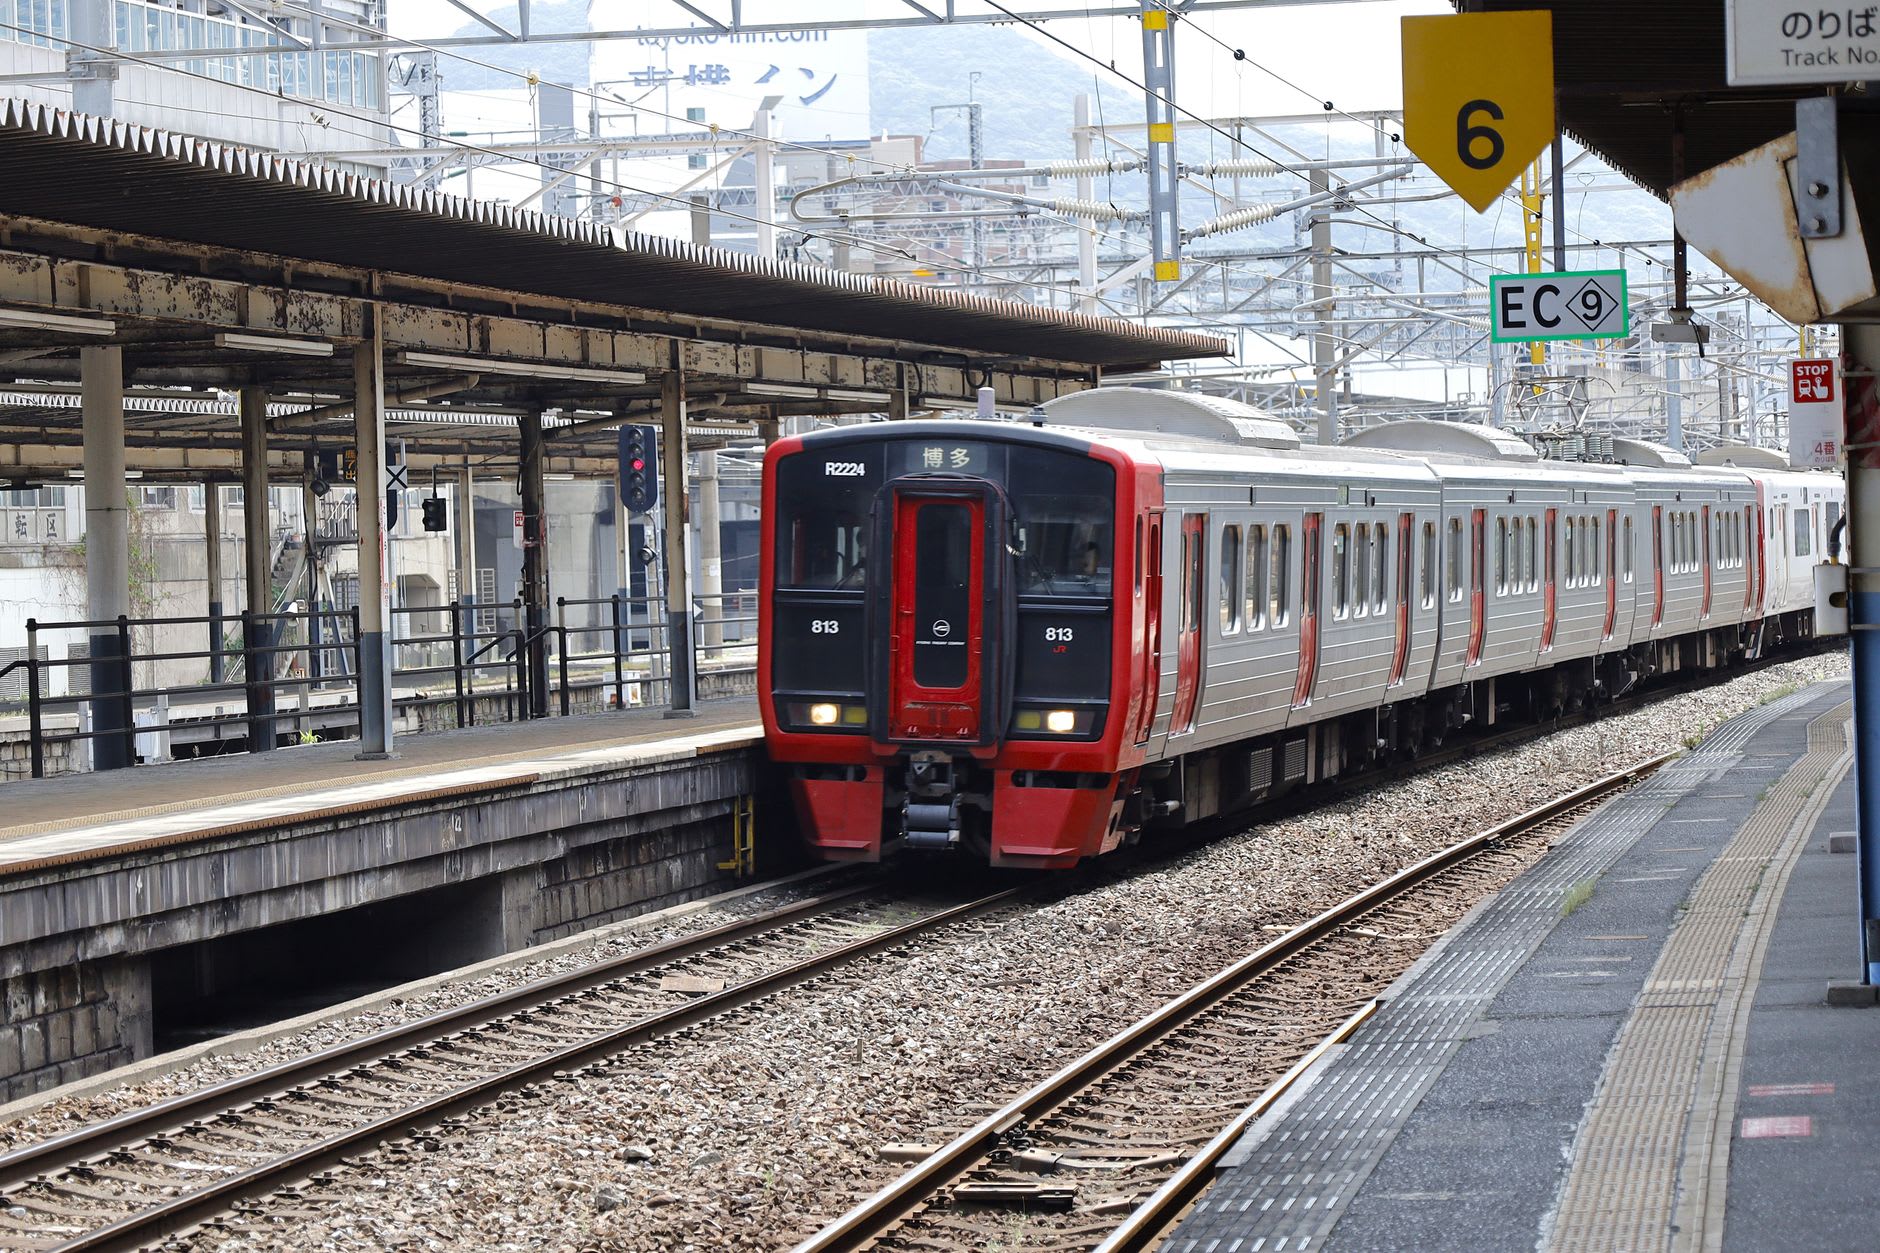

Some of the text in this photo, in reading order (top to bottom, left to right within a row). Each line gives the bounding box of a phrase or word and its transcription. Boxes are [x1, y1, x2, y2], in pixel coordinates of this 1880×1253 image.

[1782, 6, 1878, 39] のりば
[1781, 47, 1839, 66] Track
[1457, 99, 1505, 170] 6
[1501, 284, 1602, 329] EC 9
[1796, 365, 1829, 376] STOP
[1815, 442, 1835, 456] 4番
[923, 448, 970, 469] 博多
[825, 462, 866, 476] R2224
[811, 620, 839, 633] 813
[1045, 627, 1073, 641] 813
